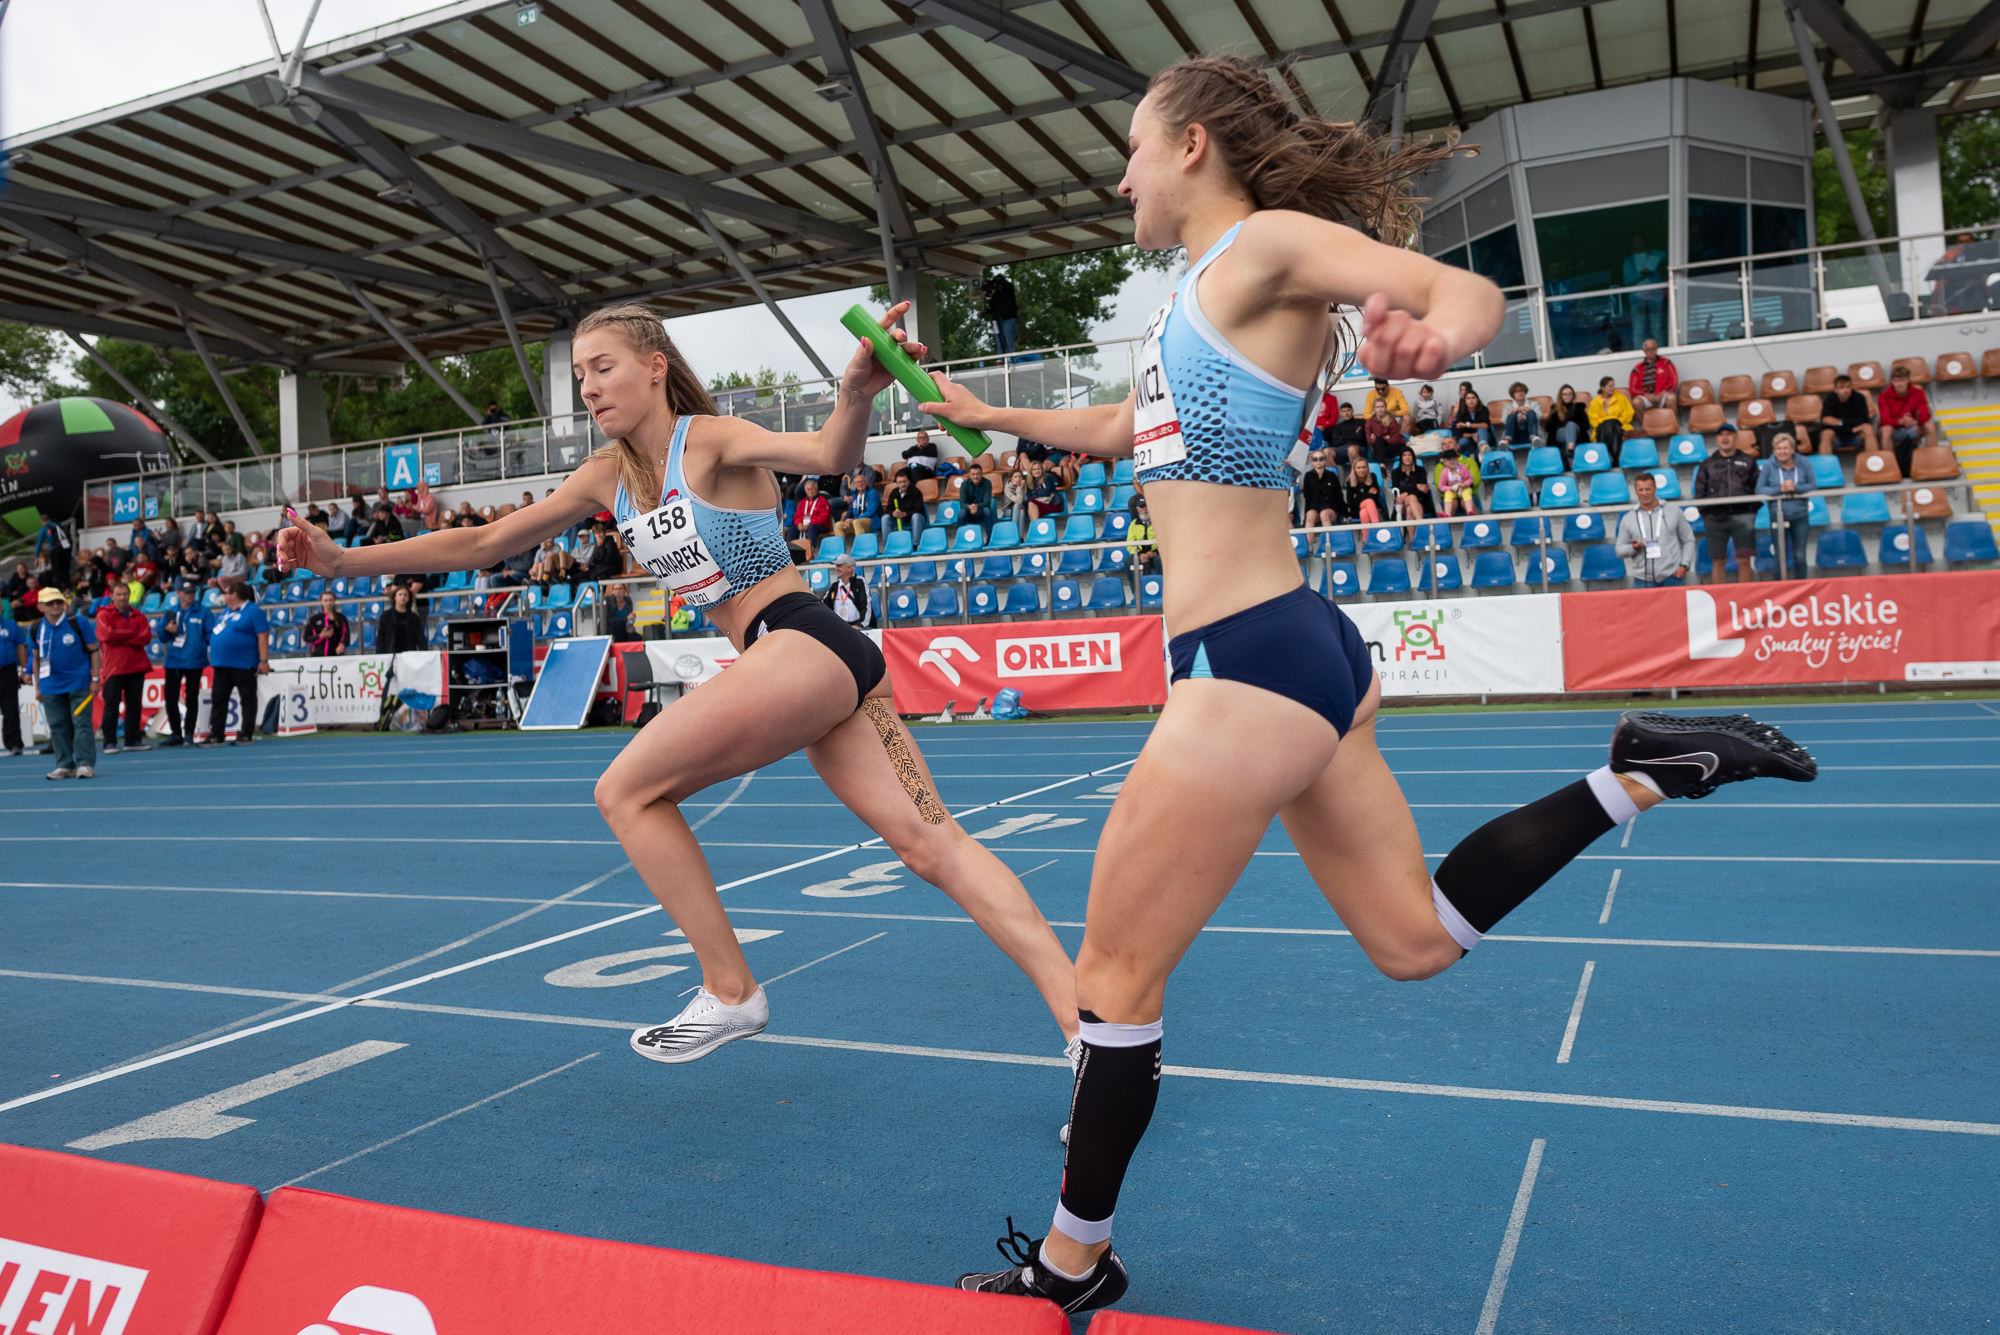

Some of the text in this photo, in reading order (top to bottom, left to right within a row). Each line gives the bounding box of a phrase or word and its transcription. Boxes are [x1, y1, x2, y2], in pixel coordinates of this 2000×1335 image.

[392, 456, 413, 486] A
[426, 466, 439, 477] WC
[1134, 449, 1152, 469] 021
[114, 496, 138, 514] A-D
[647, 506, 687, 540] 158
[642, 541, 709, 580] CZMAREK
[1729, 592, 1898, 631] lubelskie
[1003, 639, 1112, 671] ORLEN
[1754, 629, 1903, 668] Smakuj życie!
[1380, 669, 1447, 681] PIRACJI
[292, 693, 309, 722] 3
[334, 703, 377, 713] INSPIRAC
[63, 1040, 410, 1150] 1
[0, 1261, 122, 1335] LEN
